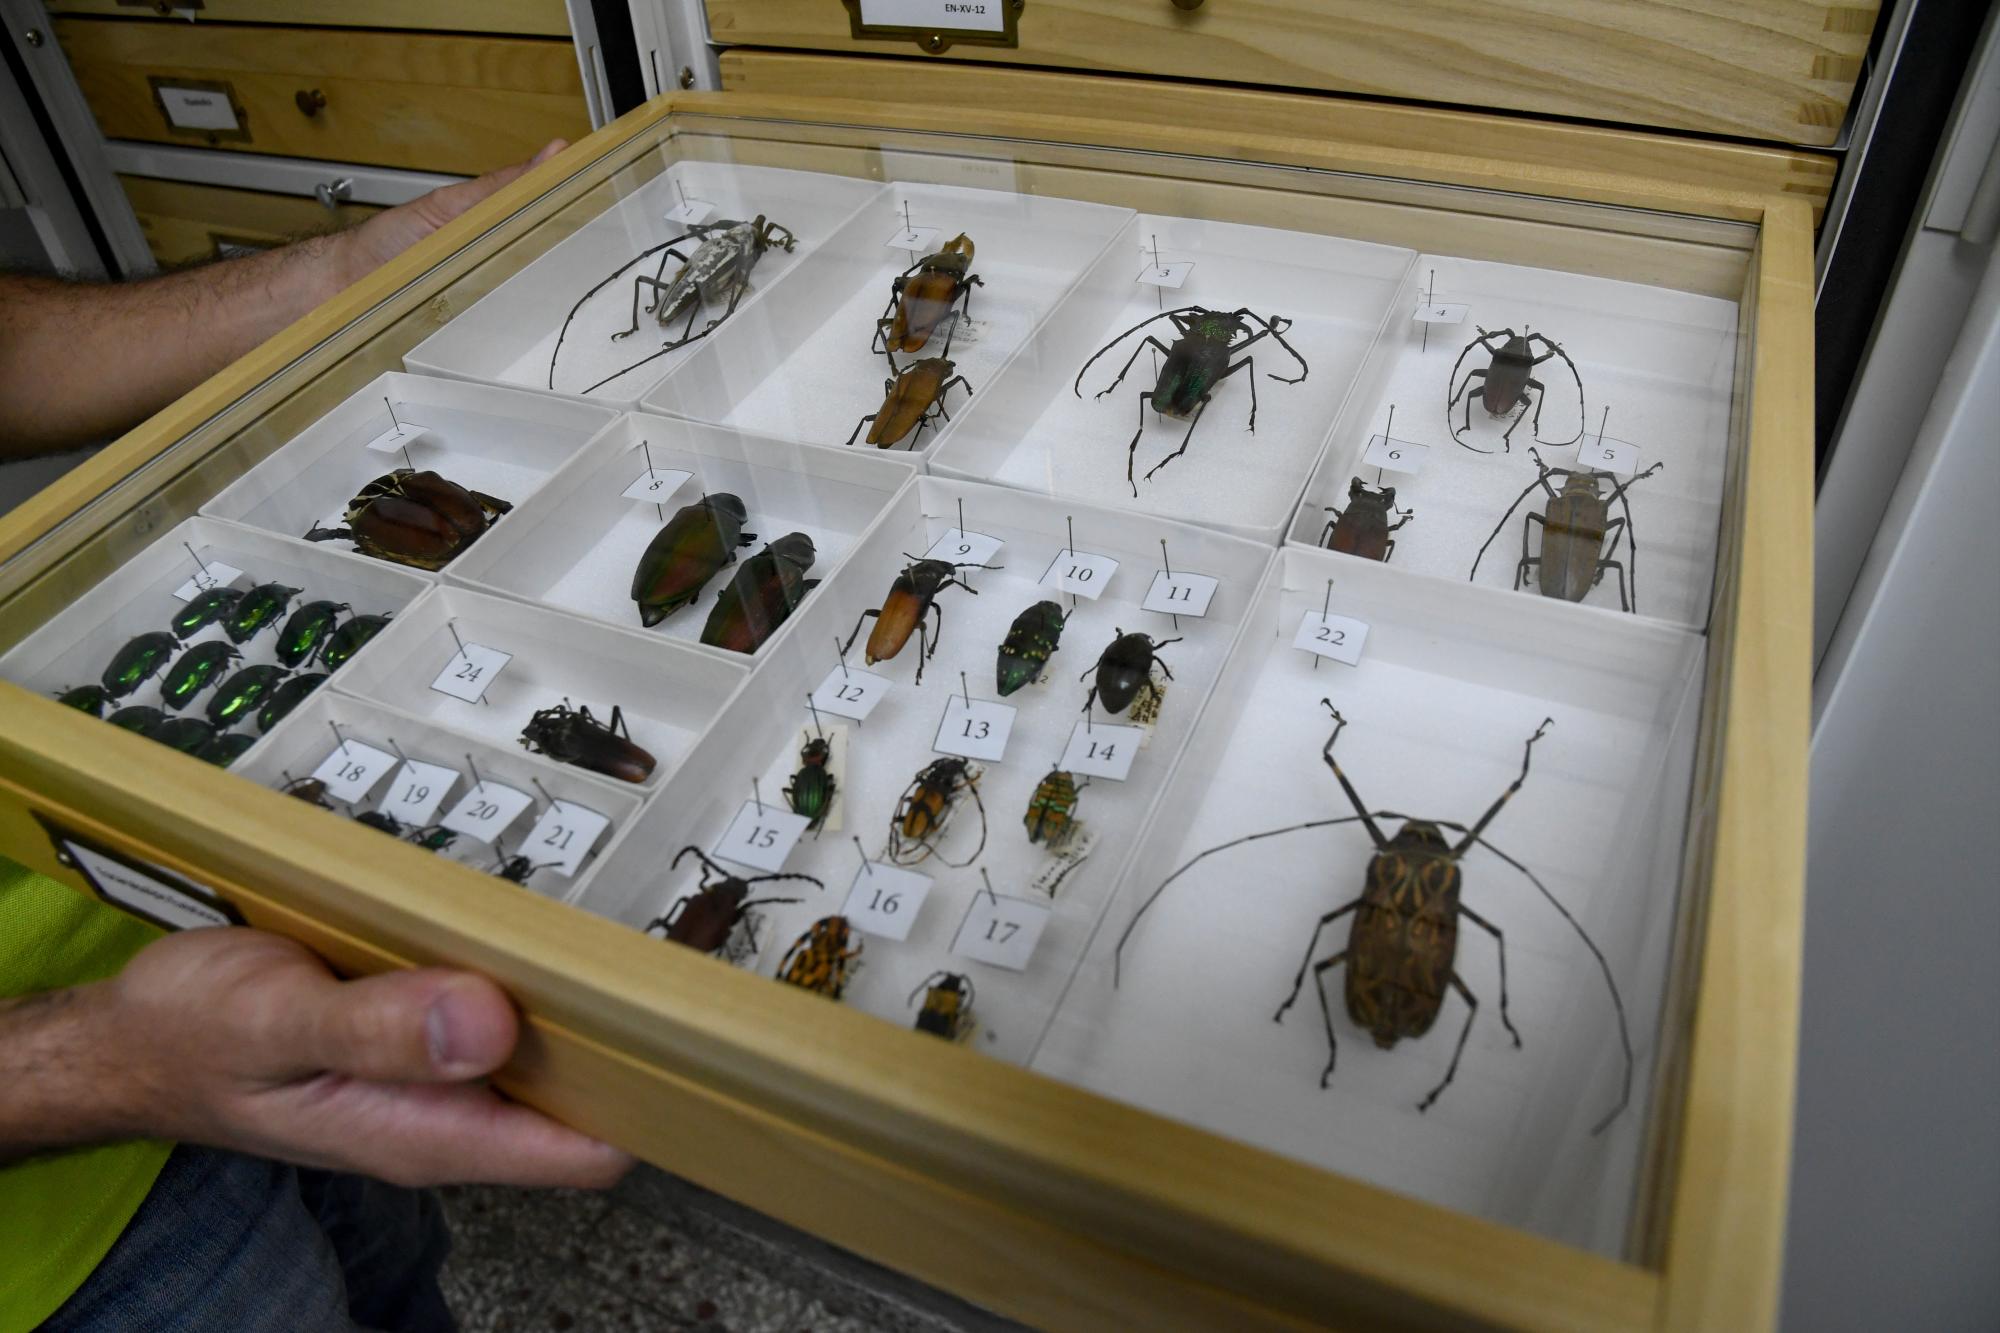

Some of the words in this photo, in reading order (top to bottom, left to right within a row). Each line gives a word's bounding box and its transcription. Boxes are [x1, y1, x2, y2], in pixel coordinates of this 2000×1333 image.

[945, 3, 986, 14] EN-XV-12
[906, 234, 918, 242] 2
[1158, 269, 1170, 278] 3
[1436, 309, 1446, 317] 4
[389, 432, 405, 442] 7
[1388, 448, 1401, 460] 6
[1602, 448, 1615, 460] 5
[648, 480, 664, 491] 8
[957, 544, 972, 556] 9
[1066, 565, 1093, 582] 10
[1168, 587, 1192, 601] 11
[1316, 627, 1346, 646] 22
[456, 663, 484, 683] 24
[835, 685, 864, 703] 12
[962, 720, 990, 739] 13
[1086, 743, 1115, 761] 14
[336, 761, 366, 782] 18
[402, 784, 430, 805] 19
[466, 800, 499, 820] 20
[543, 825, 574, 851] 21
[746, 827, 779, 848] 15
[869, 889, 901, 914] 16
[984, 920, 1020, 944] 17
